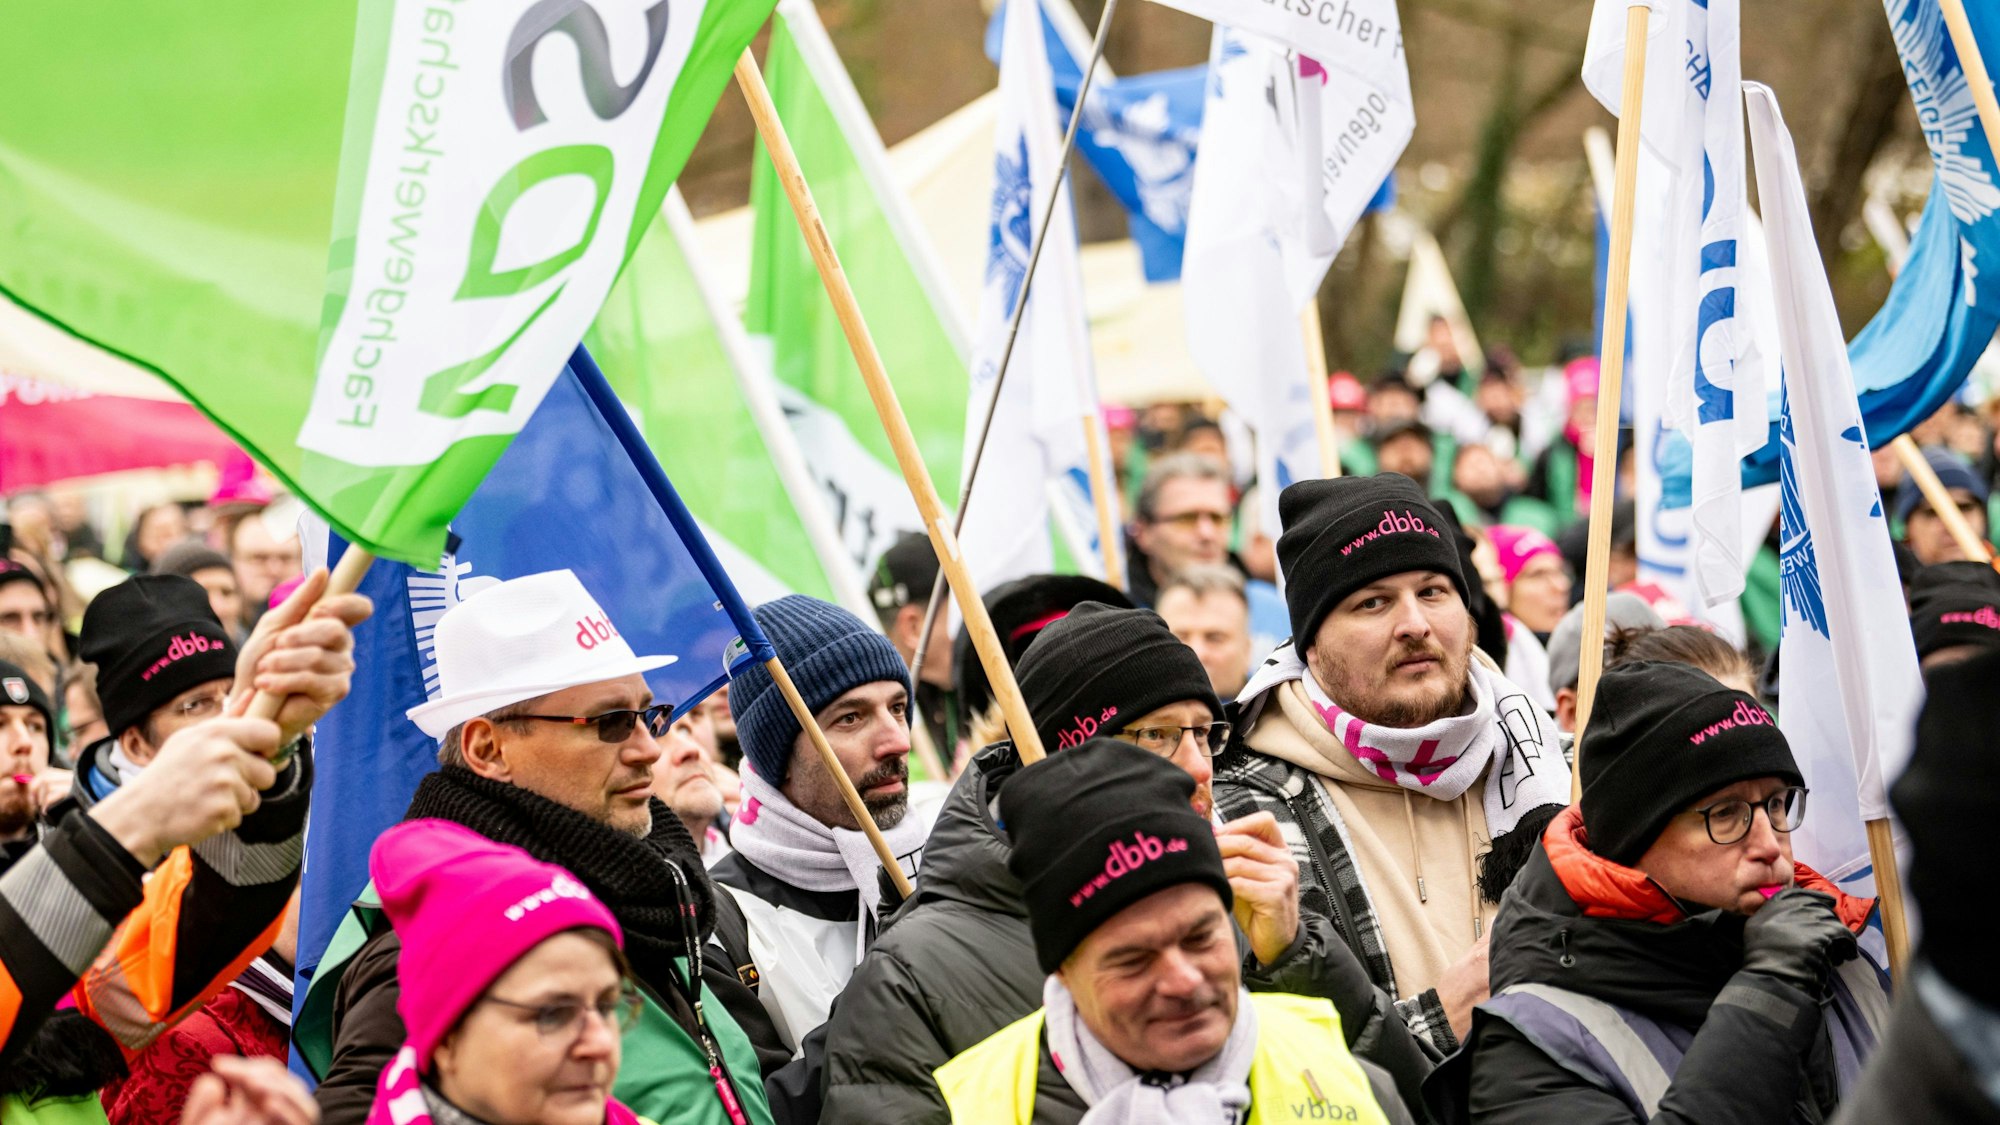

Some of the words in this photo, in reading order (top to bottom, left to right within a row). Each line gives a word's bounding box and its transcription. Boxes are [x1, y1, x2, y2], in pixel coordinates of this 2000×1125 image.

[1340, 509, 1440, 556] www.dbb.de
[1069, 829, 1189, 908] www.dbb.de
[1291, 1096, 1358, 1121] vbba
